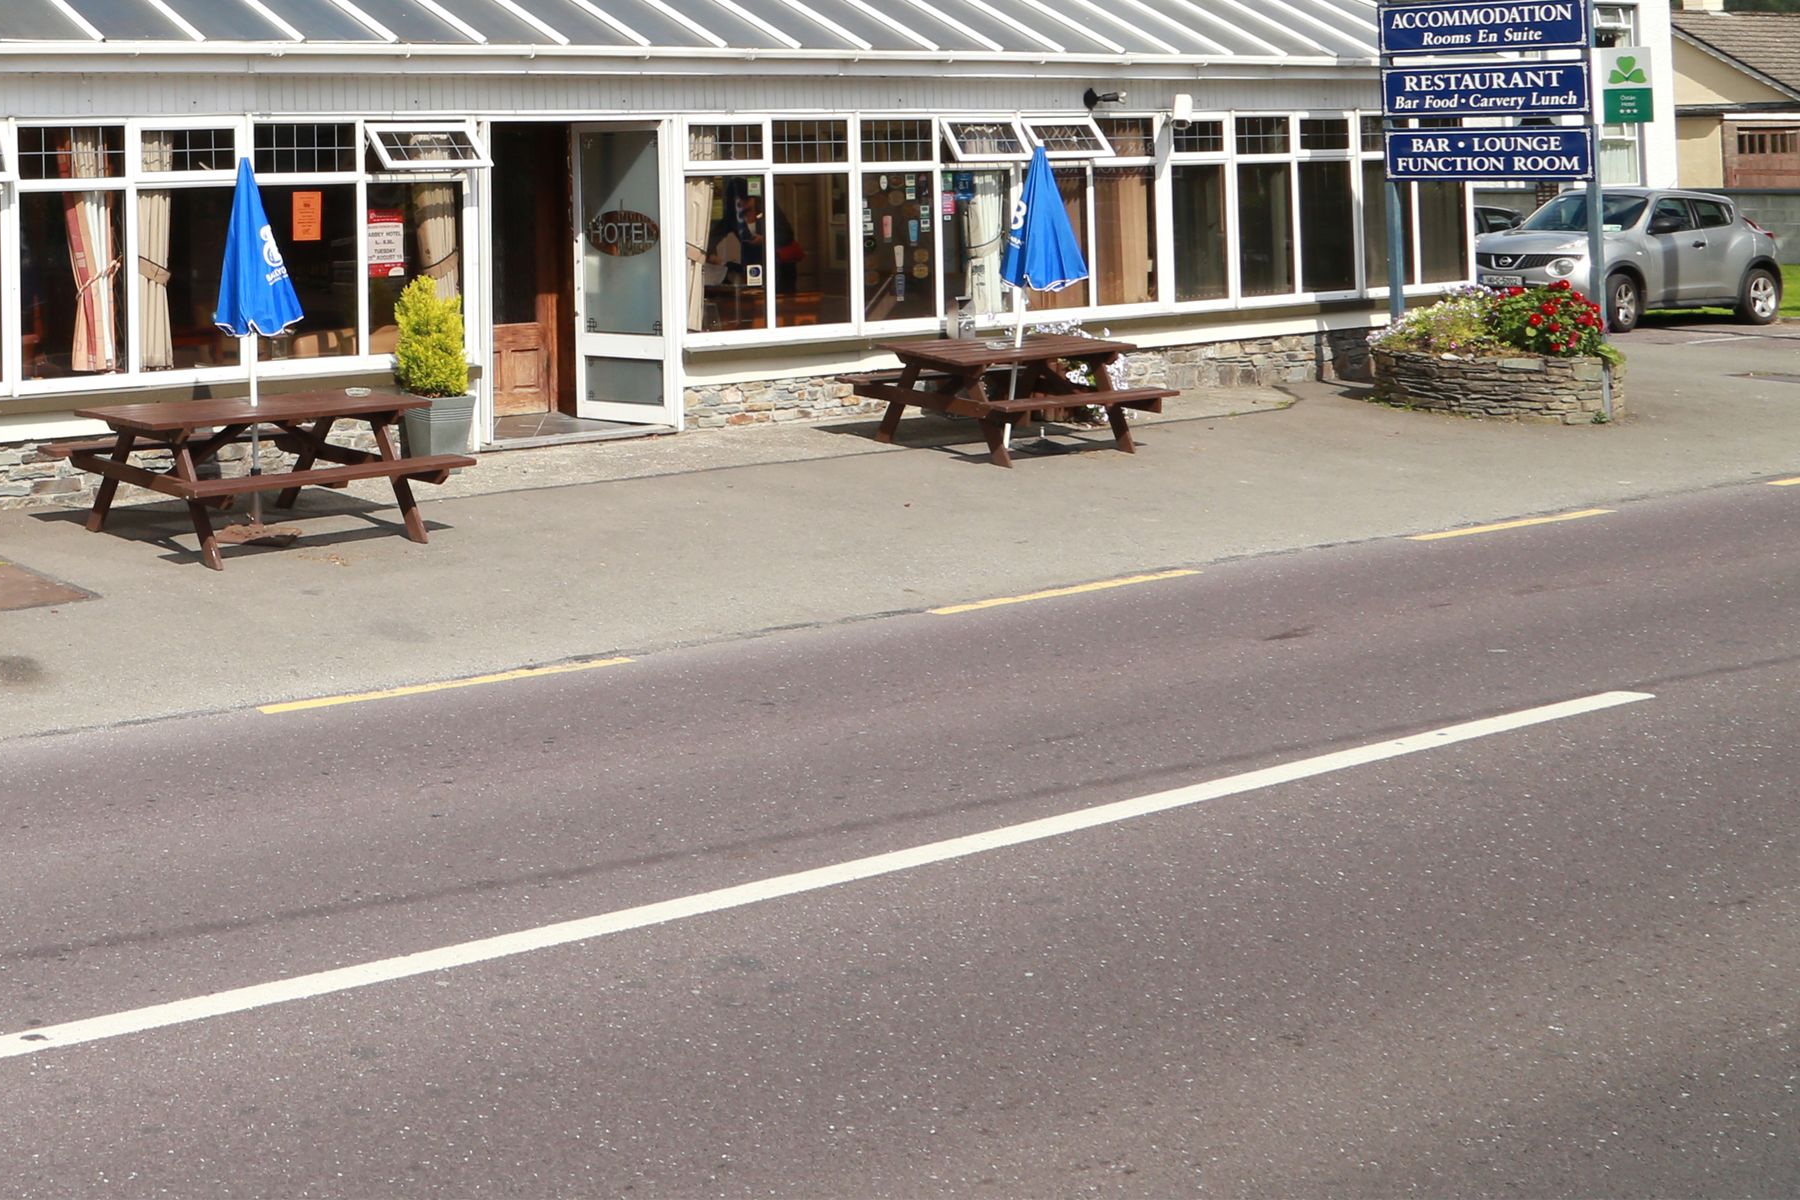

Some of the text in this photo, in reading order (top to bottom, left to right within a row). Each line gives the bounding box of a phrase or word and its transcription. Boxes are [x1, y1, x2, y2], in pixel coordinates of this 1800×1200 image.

[1391, 3, 1573, 29] ACCOMMODATION
[1422, 27, 1543, 46] Rooms En Suite
[1404, 70, 1564, 92] RESTAURANT
[1395, 90, 1577, 110] Bar Food Carvery Lunch
[1411, 136, 1563, 153] BAR LOUNGE
[1397, 155, 1581, 172] FUNCTION ROOM
[589, 222, 655, 244] HOTEL
